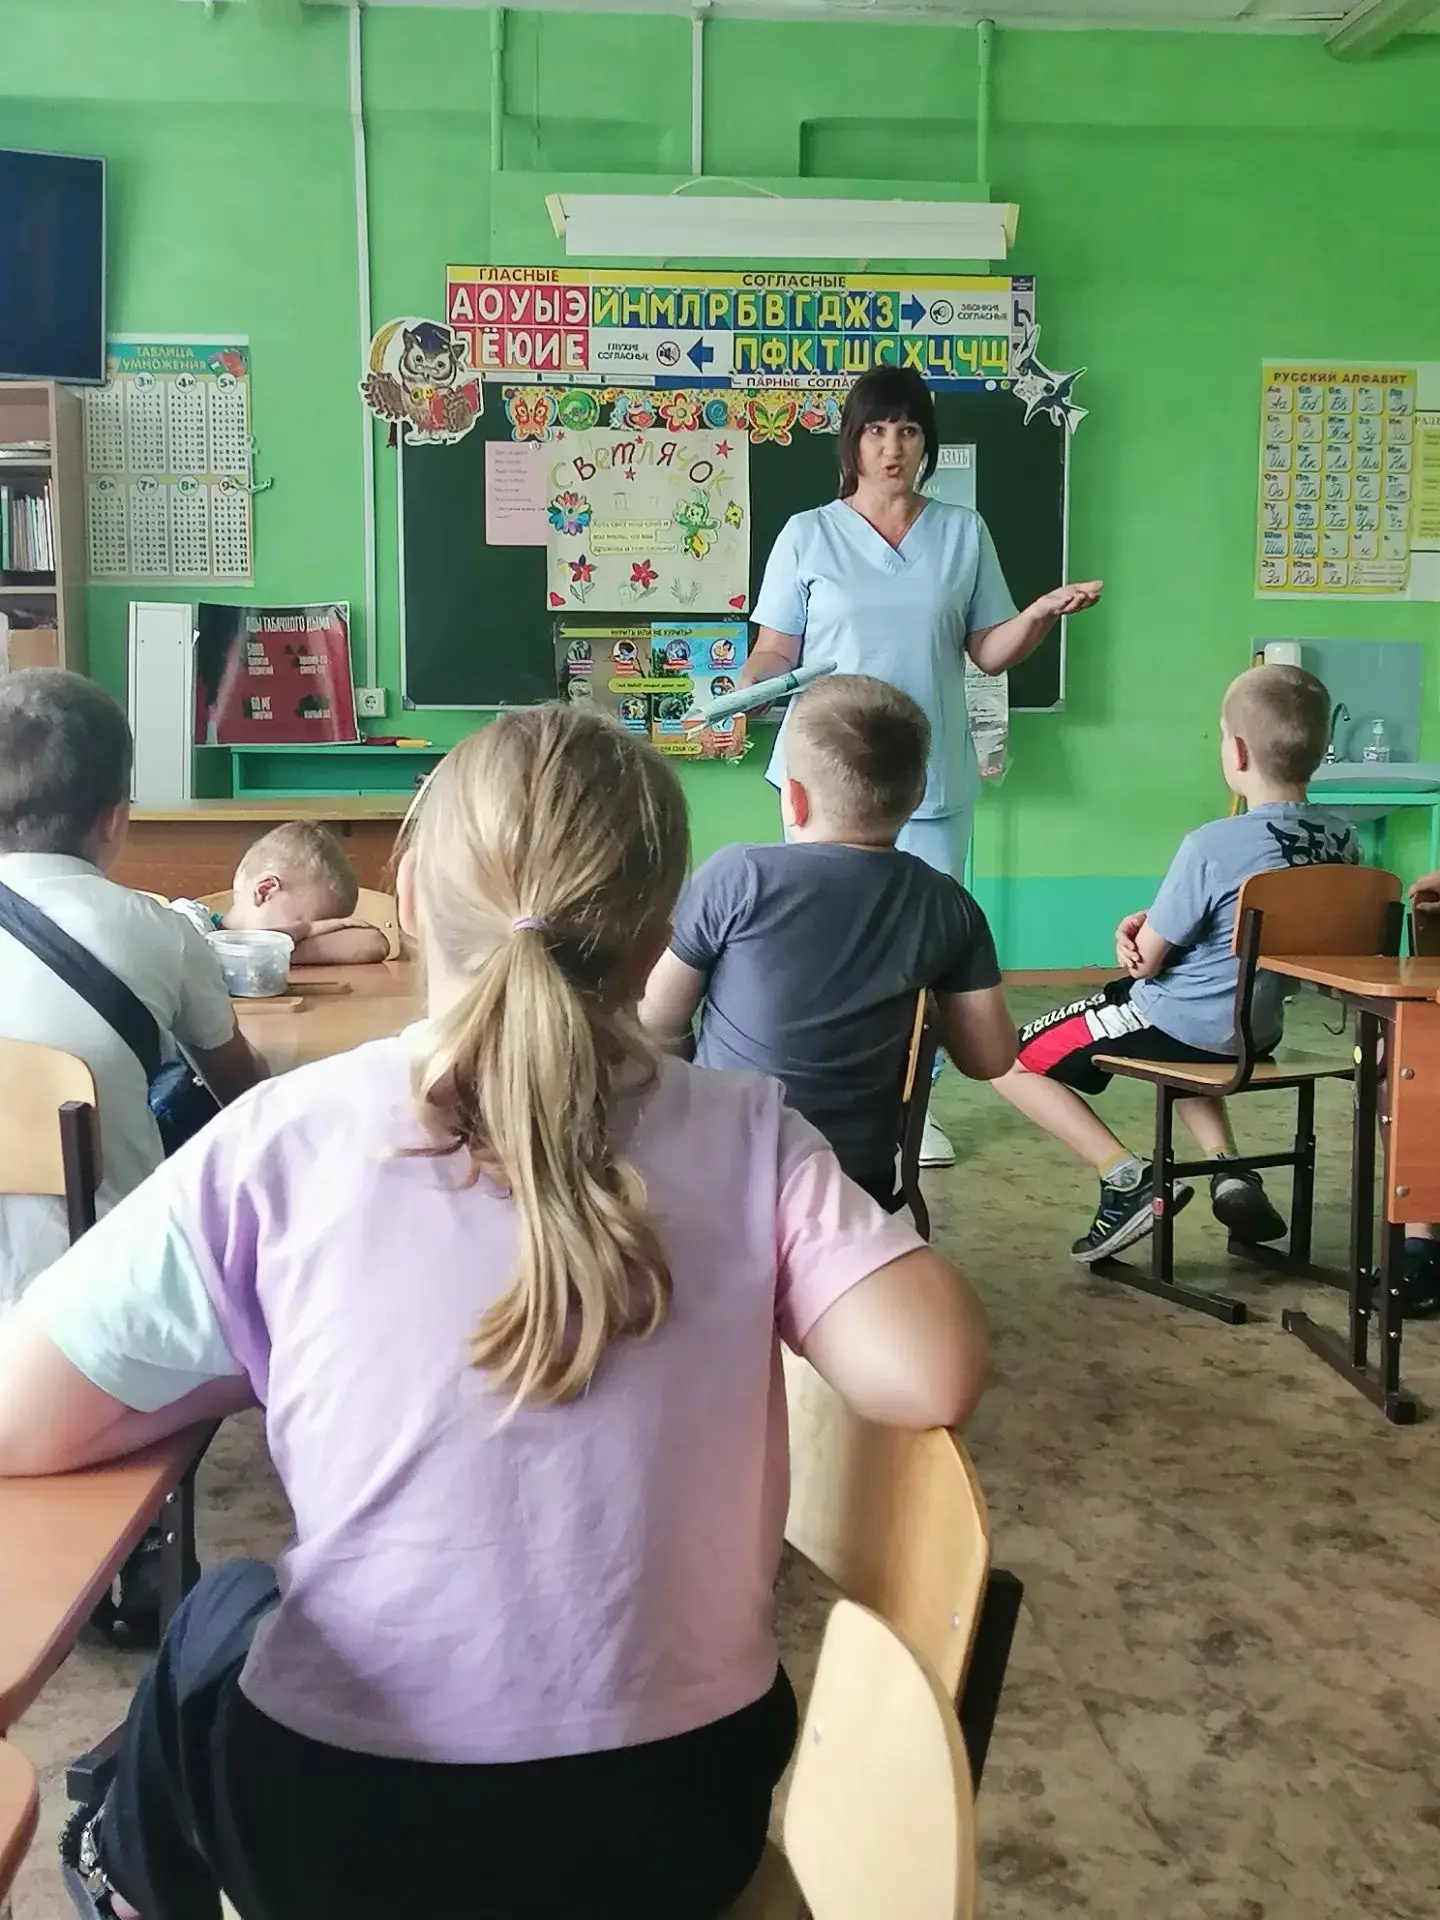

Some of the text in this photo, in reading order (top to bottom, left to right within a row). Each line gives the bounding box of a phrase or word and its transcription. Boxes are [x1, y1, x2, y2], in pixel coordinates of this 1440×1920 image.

[479, 268, 559, 282] ГЛАСНЫЕ
[742, 274, 846, 288] СОГЛАСНЫЕ
[136, 346, 194, 358] ТАБЛИЦА
[122, 359, 206, 370] УМНОЖЕНИЯ
[746, 377, 857, 388] ПАРНЫЕ СОГЛАС
[1273, 372, 1407, 384] РУССКИЙ АЛФАВИТ
[263, 616, 305, 633] ТАБАЧНОГО
